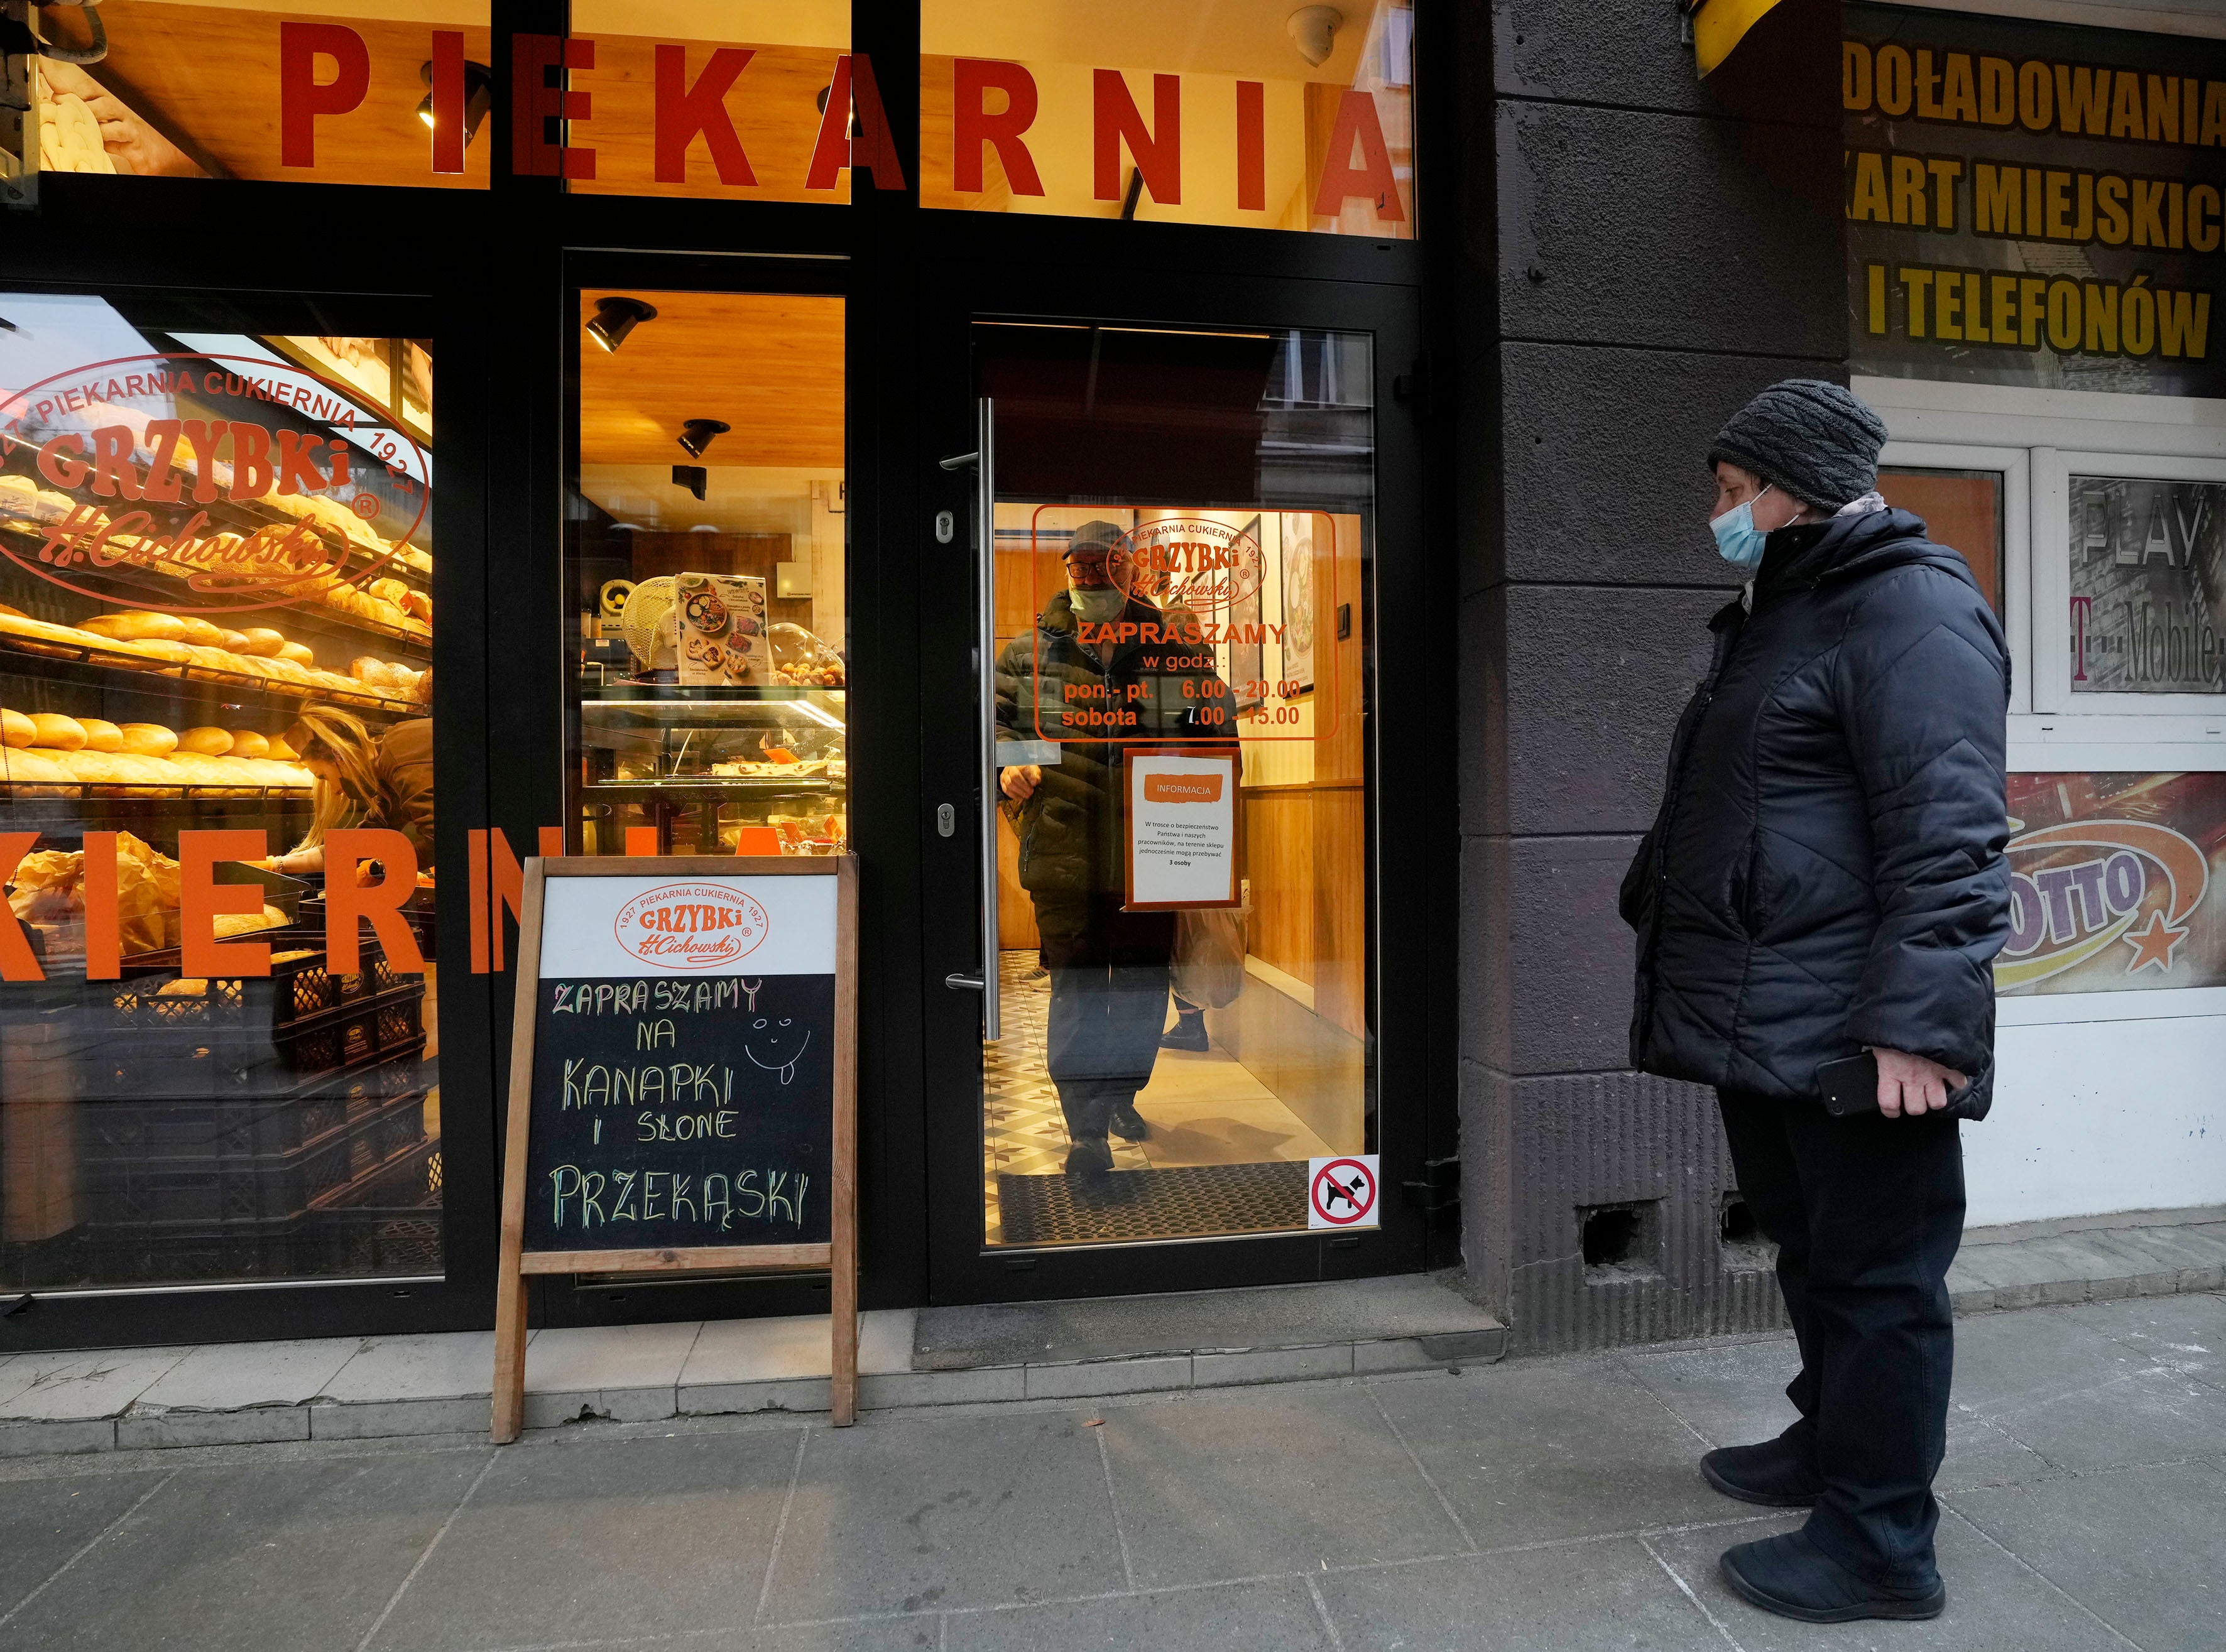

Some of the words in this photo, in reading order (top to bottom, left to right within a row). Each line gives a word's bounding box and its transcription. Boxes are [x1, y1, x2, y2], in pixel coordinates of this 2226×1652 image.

[1841, 41, 2226, 147] DOŁADOWANIA
[281, 21, 1405, 222] PIEKARNIA
[1844, 151, 1961, 229] ART
[1975, 163, 2226, 252] MIEJSKIC
[1869, 265, 1885, 334] I
[1900, 268, 2211, 358] TELEFONÓW
[35, 371, 195, 423] PIEKARNIA
[204, 371, 355, 432] CUKIERNIA
[367, 432, 413, 495] 1927
[1132, 524, 1185, 545] PIEKARNIA
[1188, 524, 1241, 546] CUKIERNIA
[2082, 491, 2205, 570] PLAY
[1077, 622, 1287, 644] ZAPRASZAMY
[1143, 656, 1159, 668] w
[1127, 680, 1154, 703] pt.
[1182, 680, 1225, 698] 6.00
[1246, 680, 1300, 698] 20.00
[1062, 707, 1137, 725] sobota
[1186, 706, 1225, 725] 7.00
[1245, 707, 1299, 725] 15.00
[1157, 784, 1211, 795] INFORMACJA
[1138, 839, 1176, 847] pracowników,
[1139, 847, 1175, 856] jednocześnie
[0, 826, 783, 982] IERN
[640, 889, 692, 908] PIEKARNIA
[694, 888, 745, 908] CUKIERNIA
[2004, 854, 2142, 952] OTTO
[619, 906, 636, 930] 1927
[748, 906, 763, 928] 1927
[552, 977, 763, 1016] ZAPRASZAMY
[636, 1019, 675, 1052] NA
[562, 1057, 734, 1111] KANAPKI
[594, 1117, 603, 1145] I
[637, 1110, 740, 1143] SŁONE
[549, 1164, 810, 1231] PRZEKĄSKI
